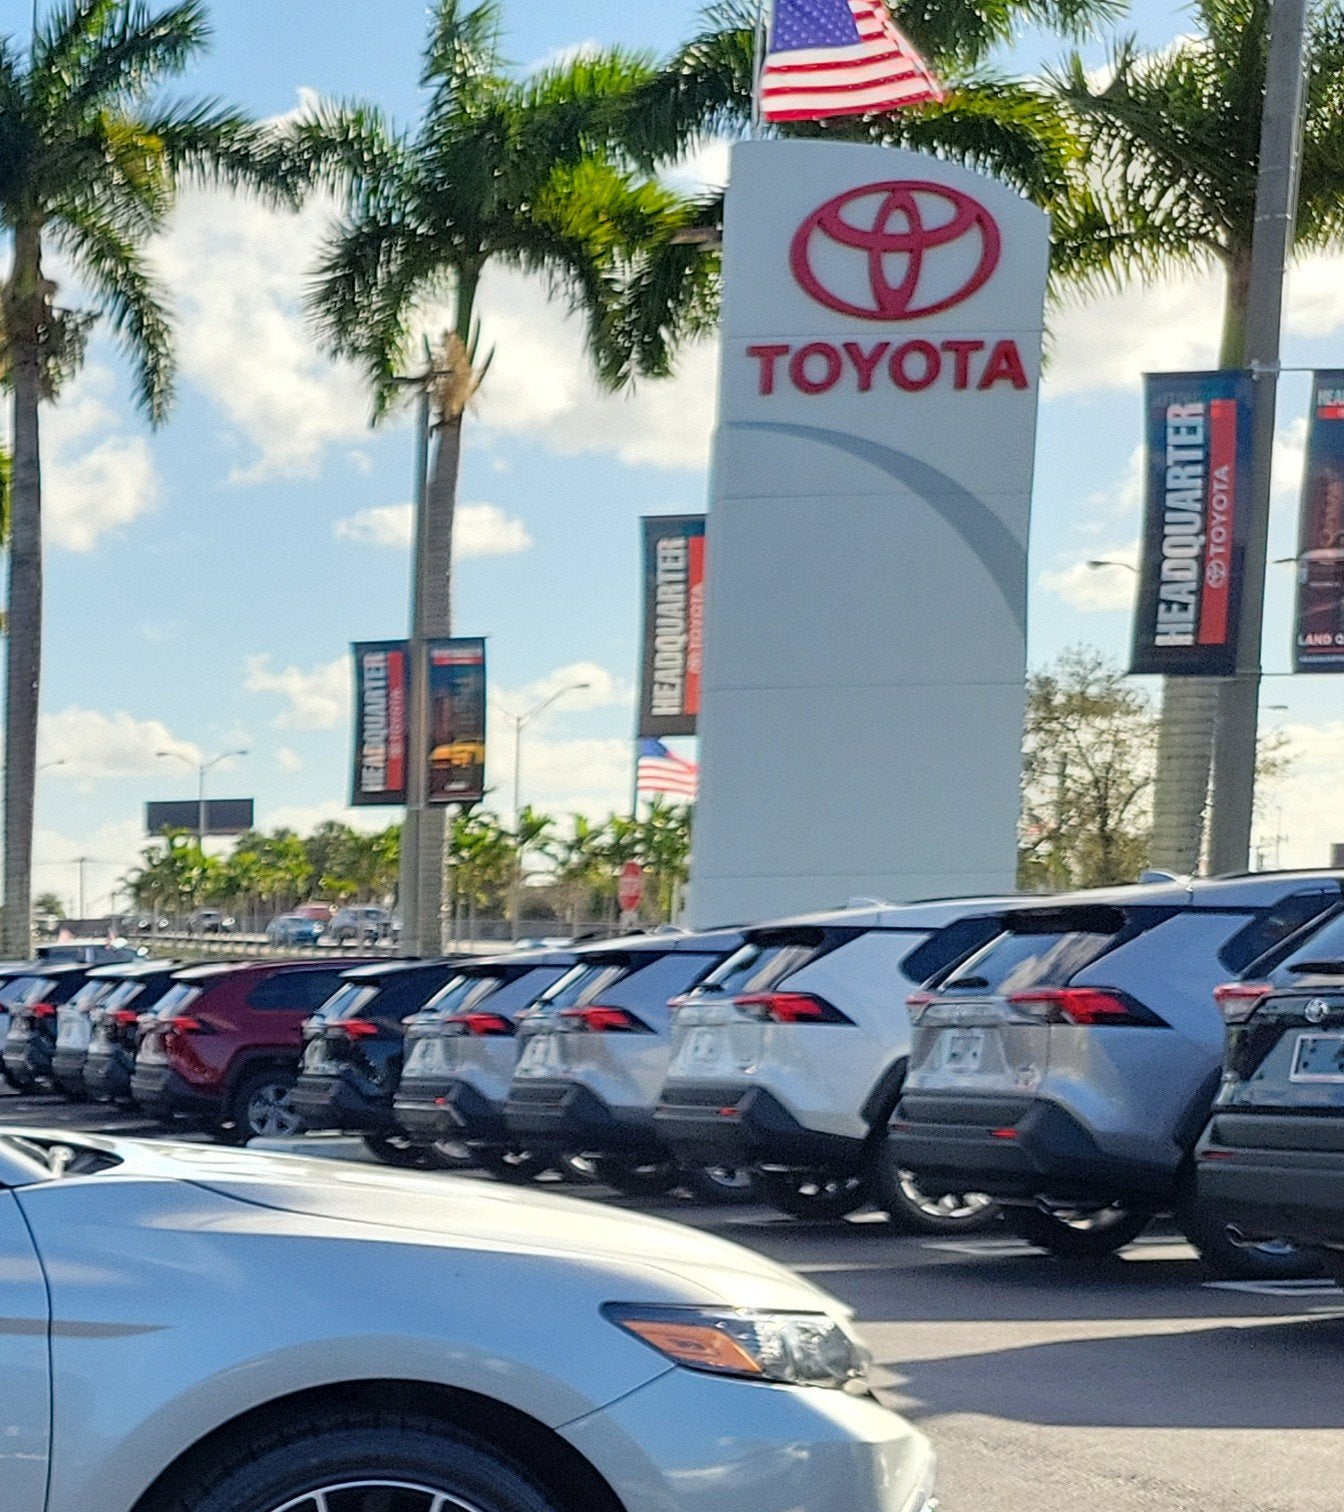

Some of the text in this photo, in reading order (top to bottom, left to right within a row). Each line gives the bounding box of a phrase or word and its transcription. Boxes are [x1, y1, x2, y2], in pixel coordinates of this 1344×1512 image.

[746, 340, 1030, 396] TOYOTA
[1155, 401, 1206, 646] HEADQUARTER
[1208, 466, 1231, 554] TOYOTA
[651, 537, 688, 716] HEADQUARTER
[362, 652, 388, 792] HEADQUARTER
